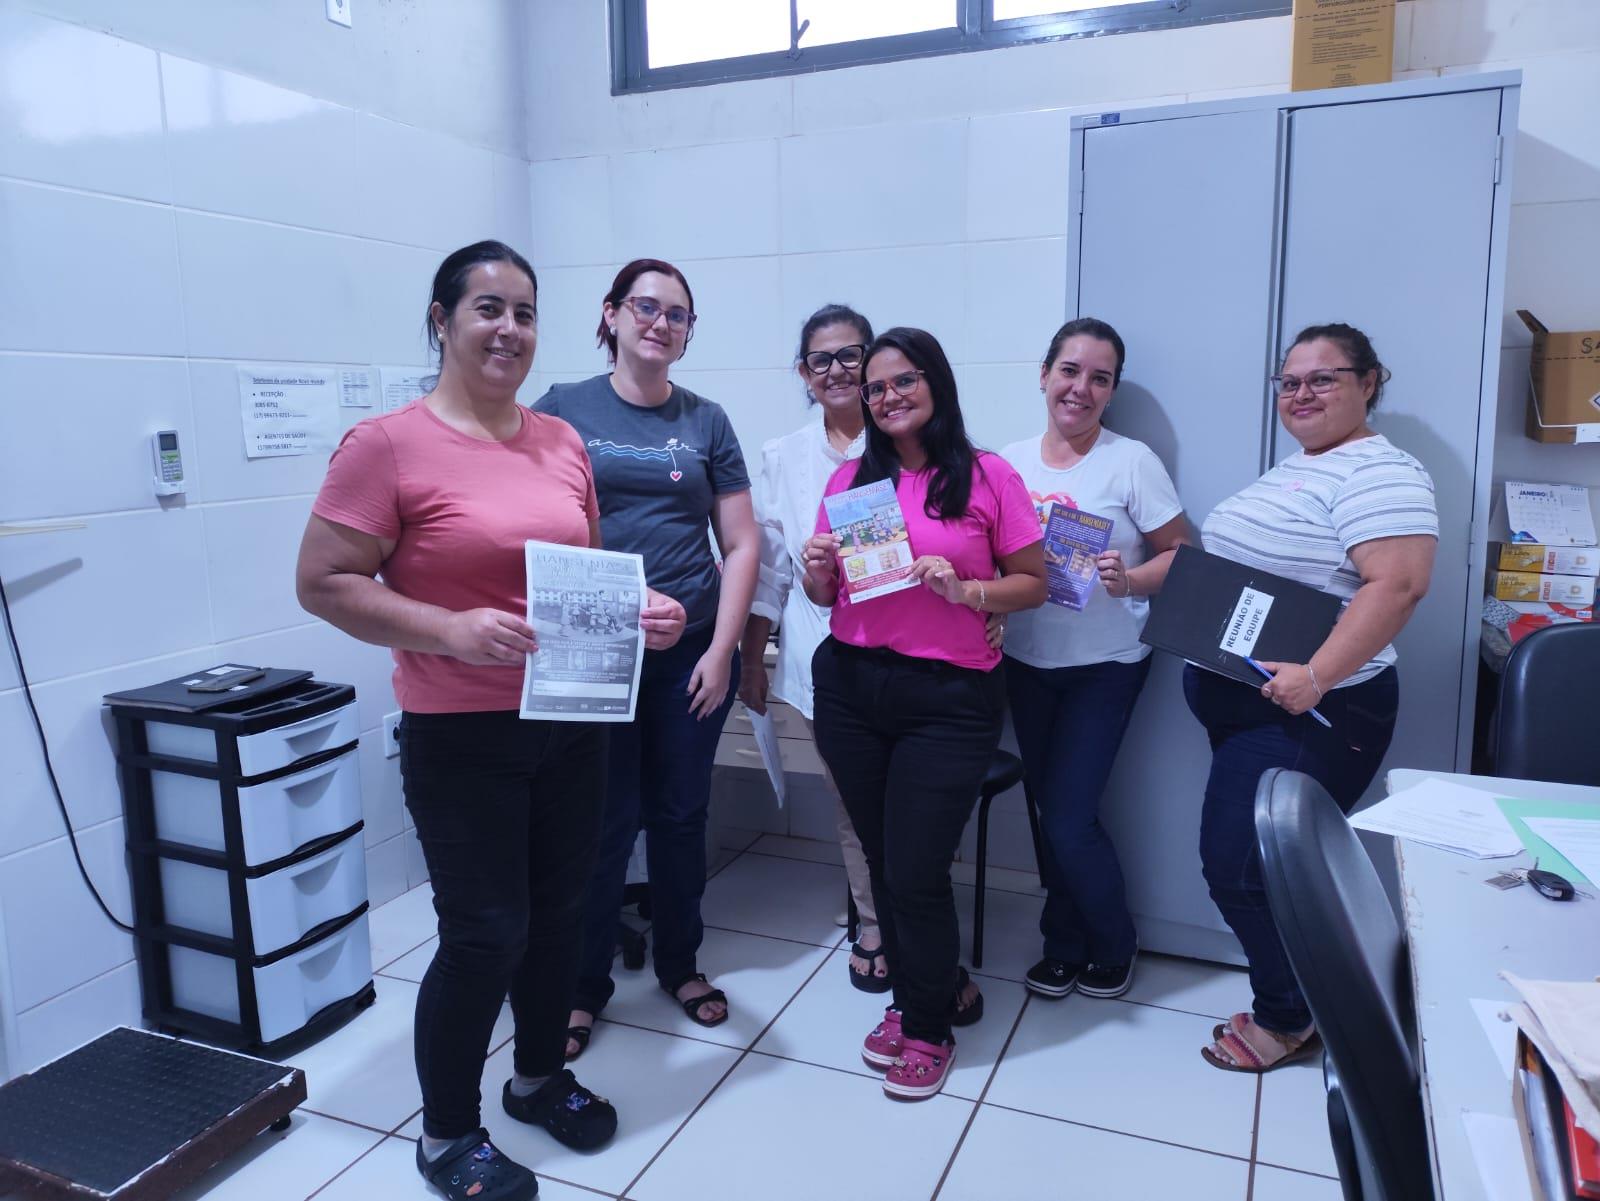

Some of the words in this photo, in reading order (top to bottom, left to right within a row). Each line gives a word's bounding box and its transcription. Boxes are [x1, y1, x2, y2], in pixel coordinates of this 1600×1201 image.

[1519, 489, 1546, 497] JANEIRO
[1244, 592, 1255, 606] DE
[1243, 607, 1264, 642] EQUIPE
